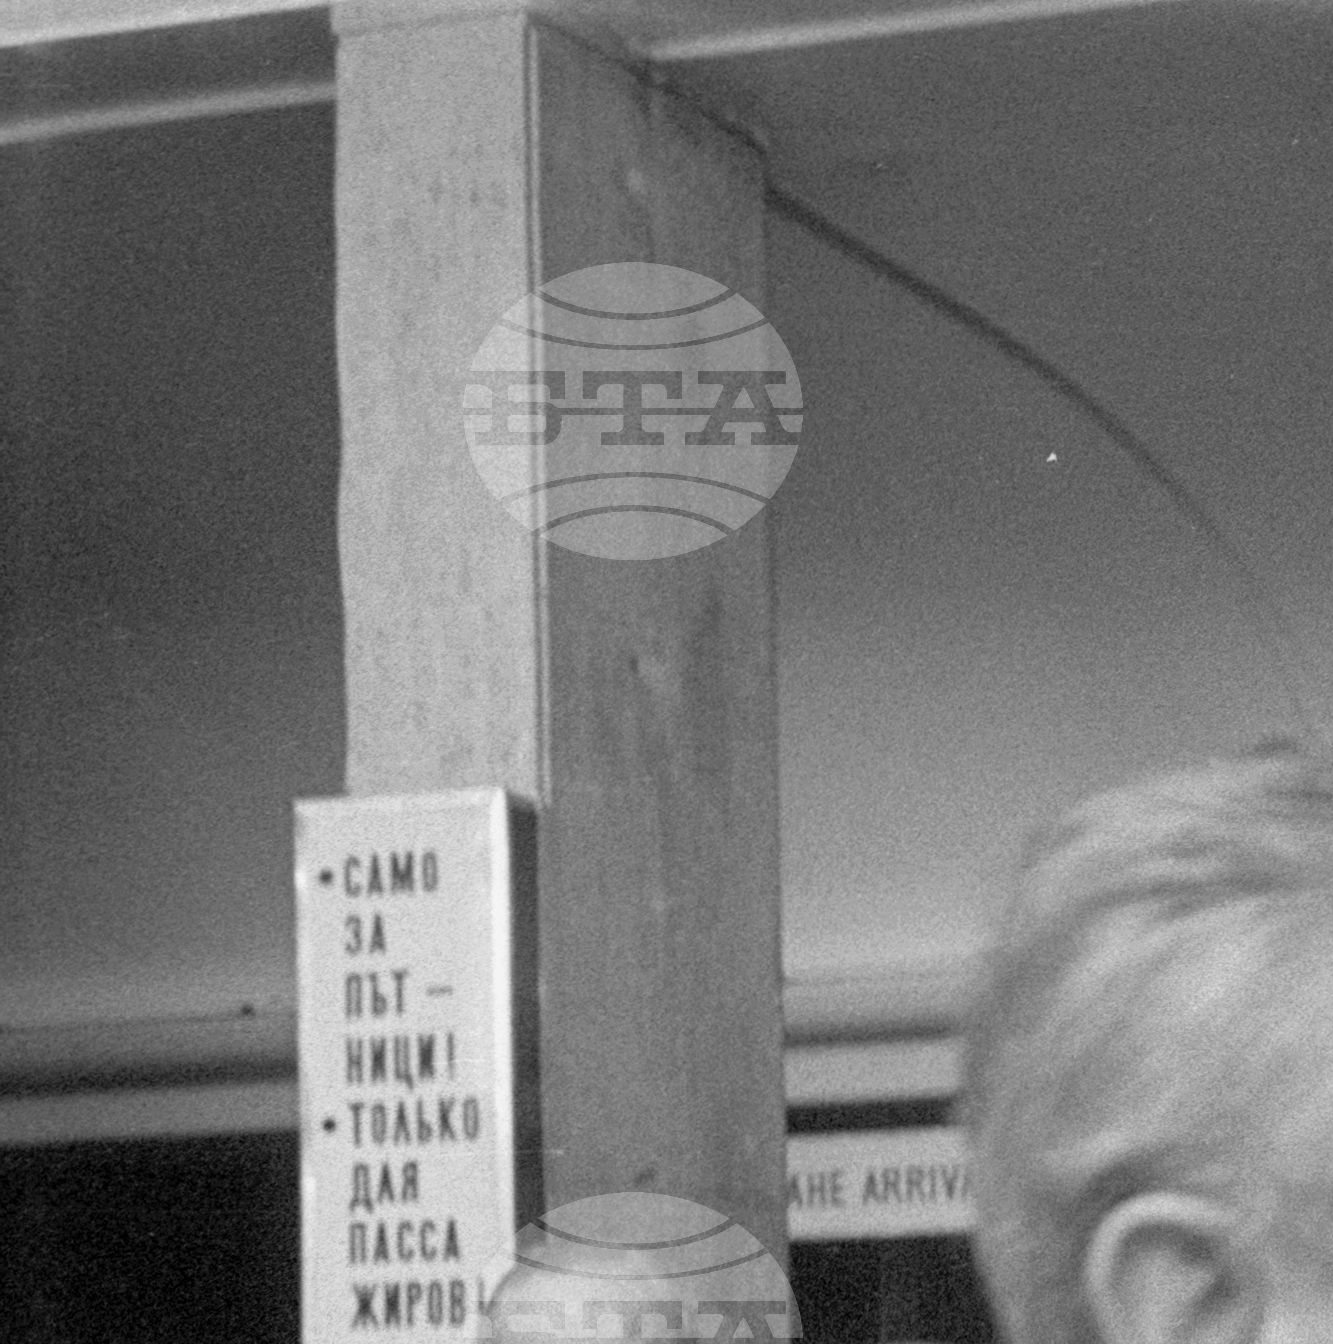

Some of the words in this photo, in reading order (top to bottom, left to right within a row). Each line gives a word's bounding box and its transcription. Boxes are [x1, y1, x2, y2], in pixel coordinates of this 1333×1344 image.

[343, 849, 439, 898] САМО
[344, 913, 388, 956] ЗА
[345, 1032, 457, 1093] НИЦИ!
[347, 1095, 481, 1149] ТОЛЬКО
[349, 1159, 422, 1216] ДЛЯ
[348, 1216, 464, 1267] ПАССА
